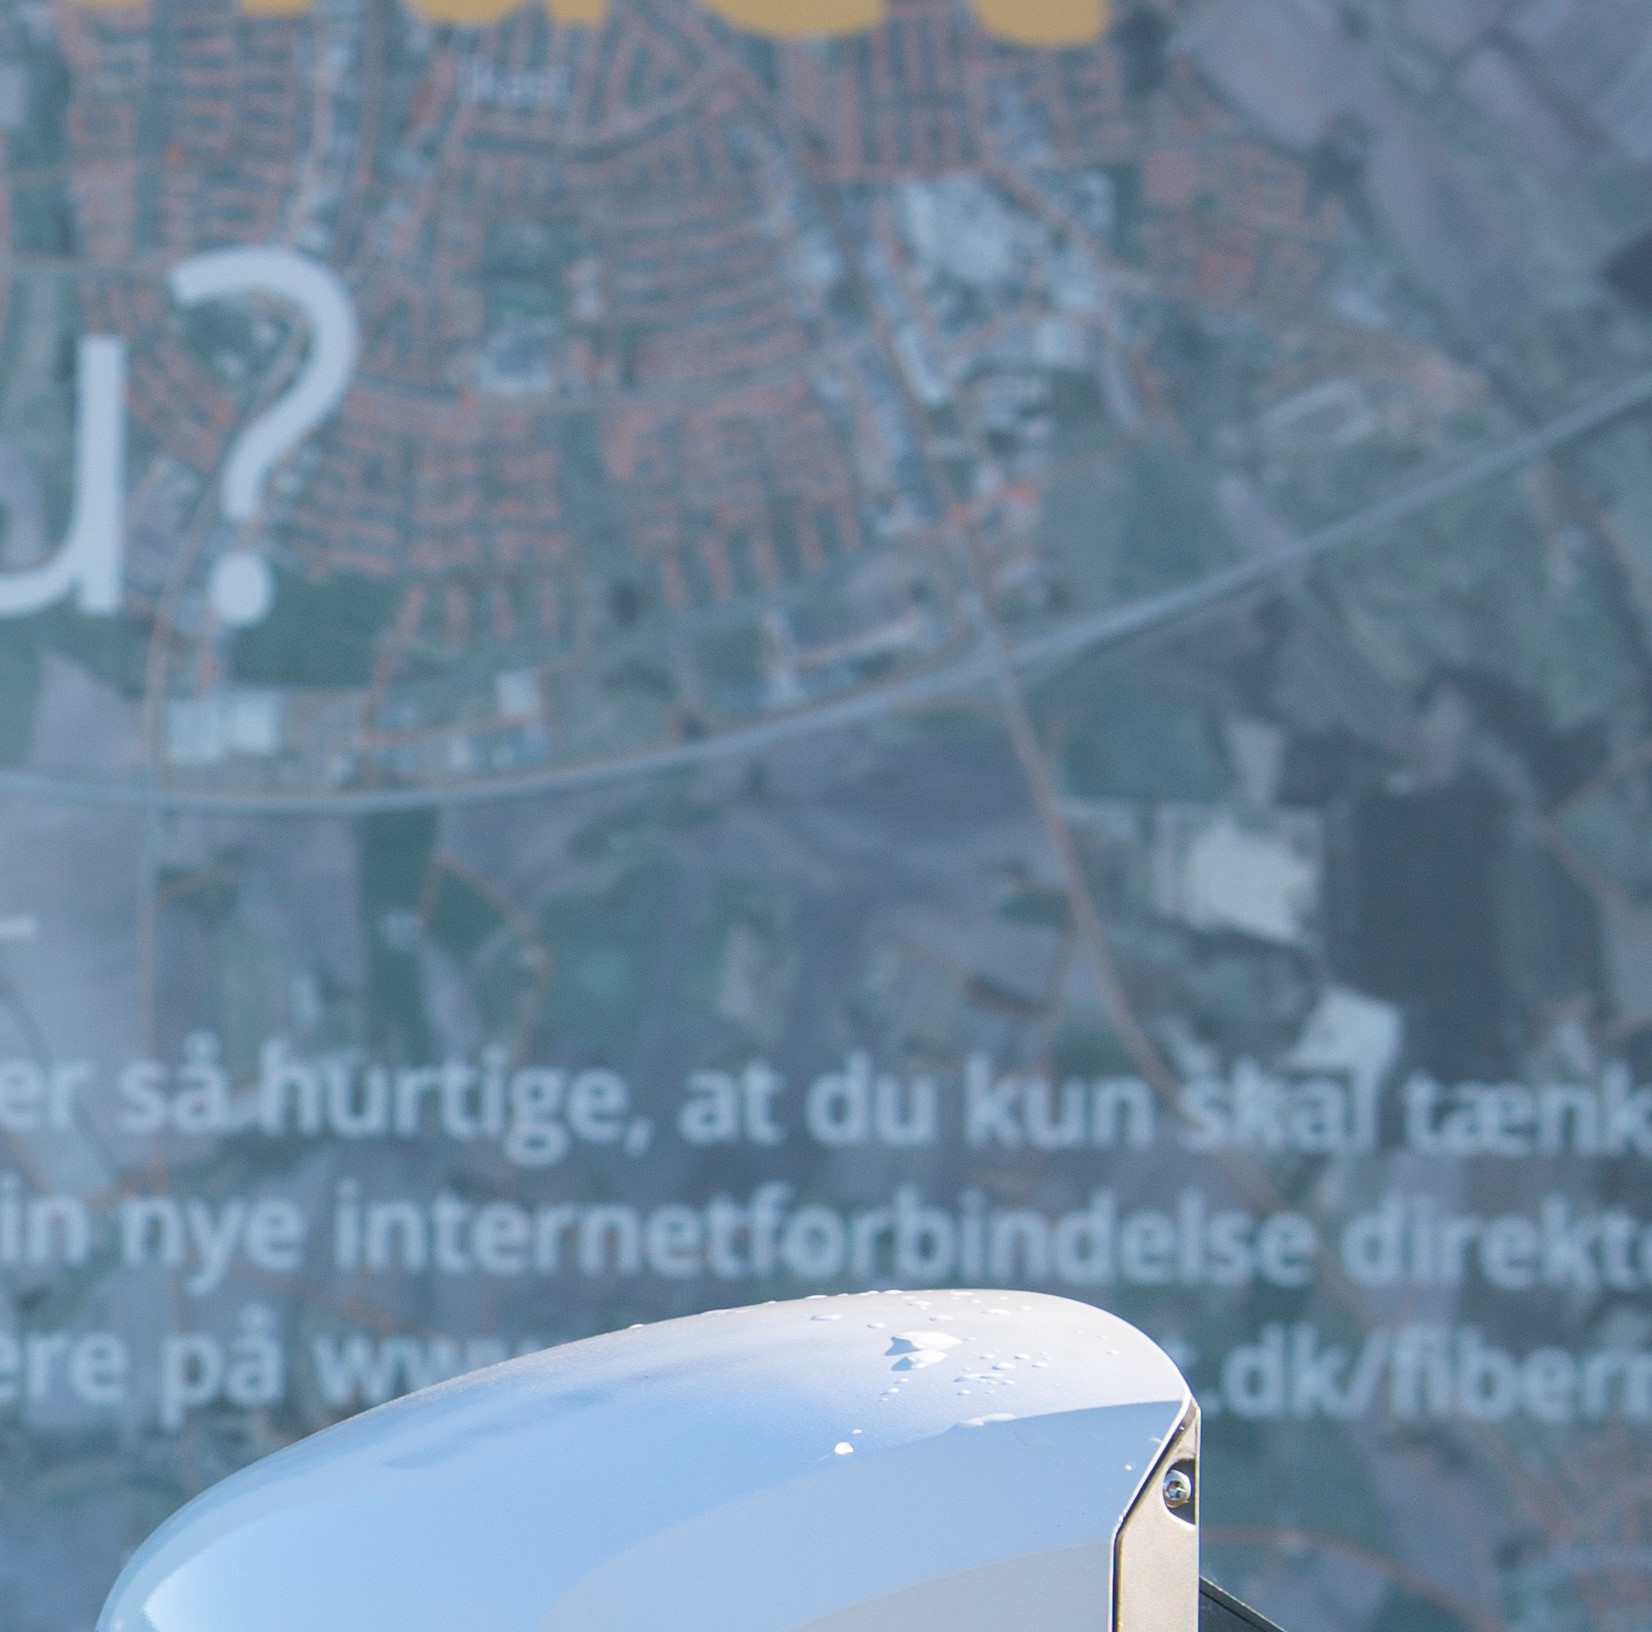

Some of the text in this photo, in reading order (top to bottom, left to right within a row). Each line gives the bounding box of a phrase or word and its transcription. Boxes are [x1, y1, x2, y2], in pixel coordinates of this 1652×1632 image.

[118, 1031, 230, 1133] så
[259, 1033, 651, 1165] hurtige,
[680, 1061, 784, 1146] at
[806, 1053, 938, 1146] du
[966, 1053, 1153, 1150] kun
[1182, 1058, 1376, 1153] skal
[120, 1195, 305, 1296] nye
[335, 1180, 1314, 1288] internetforbindelse
[1342, 1190, 1652, 1291] direkt
[163, 1306, 285, 1431] på
